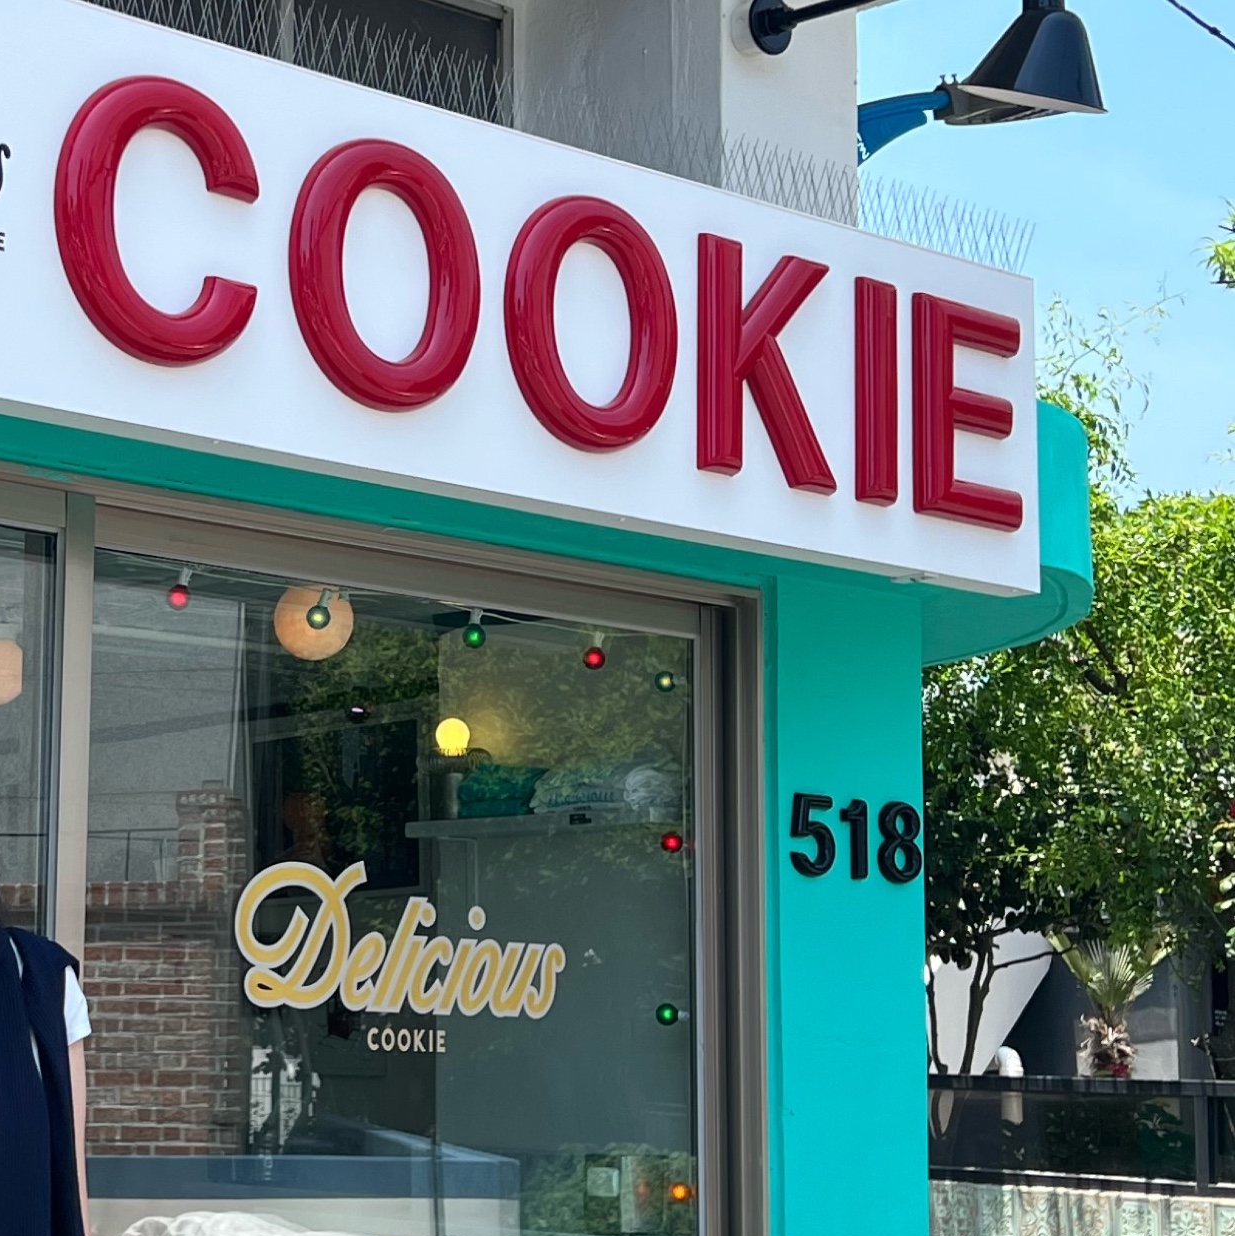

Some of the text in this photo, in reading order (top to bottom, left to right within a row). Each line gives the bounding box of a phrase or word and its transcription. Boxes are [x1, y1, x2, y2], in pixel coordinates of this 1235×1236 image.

[53, 74, 1023, 533] COOKIE
[789, 792, 923, 885] 518
[234, 860, 566, 1019] Delicious
[367, 1027, 446, 1053] COOKIE
